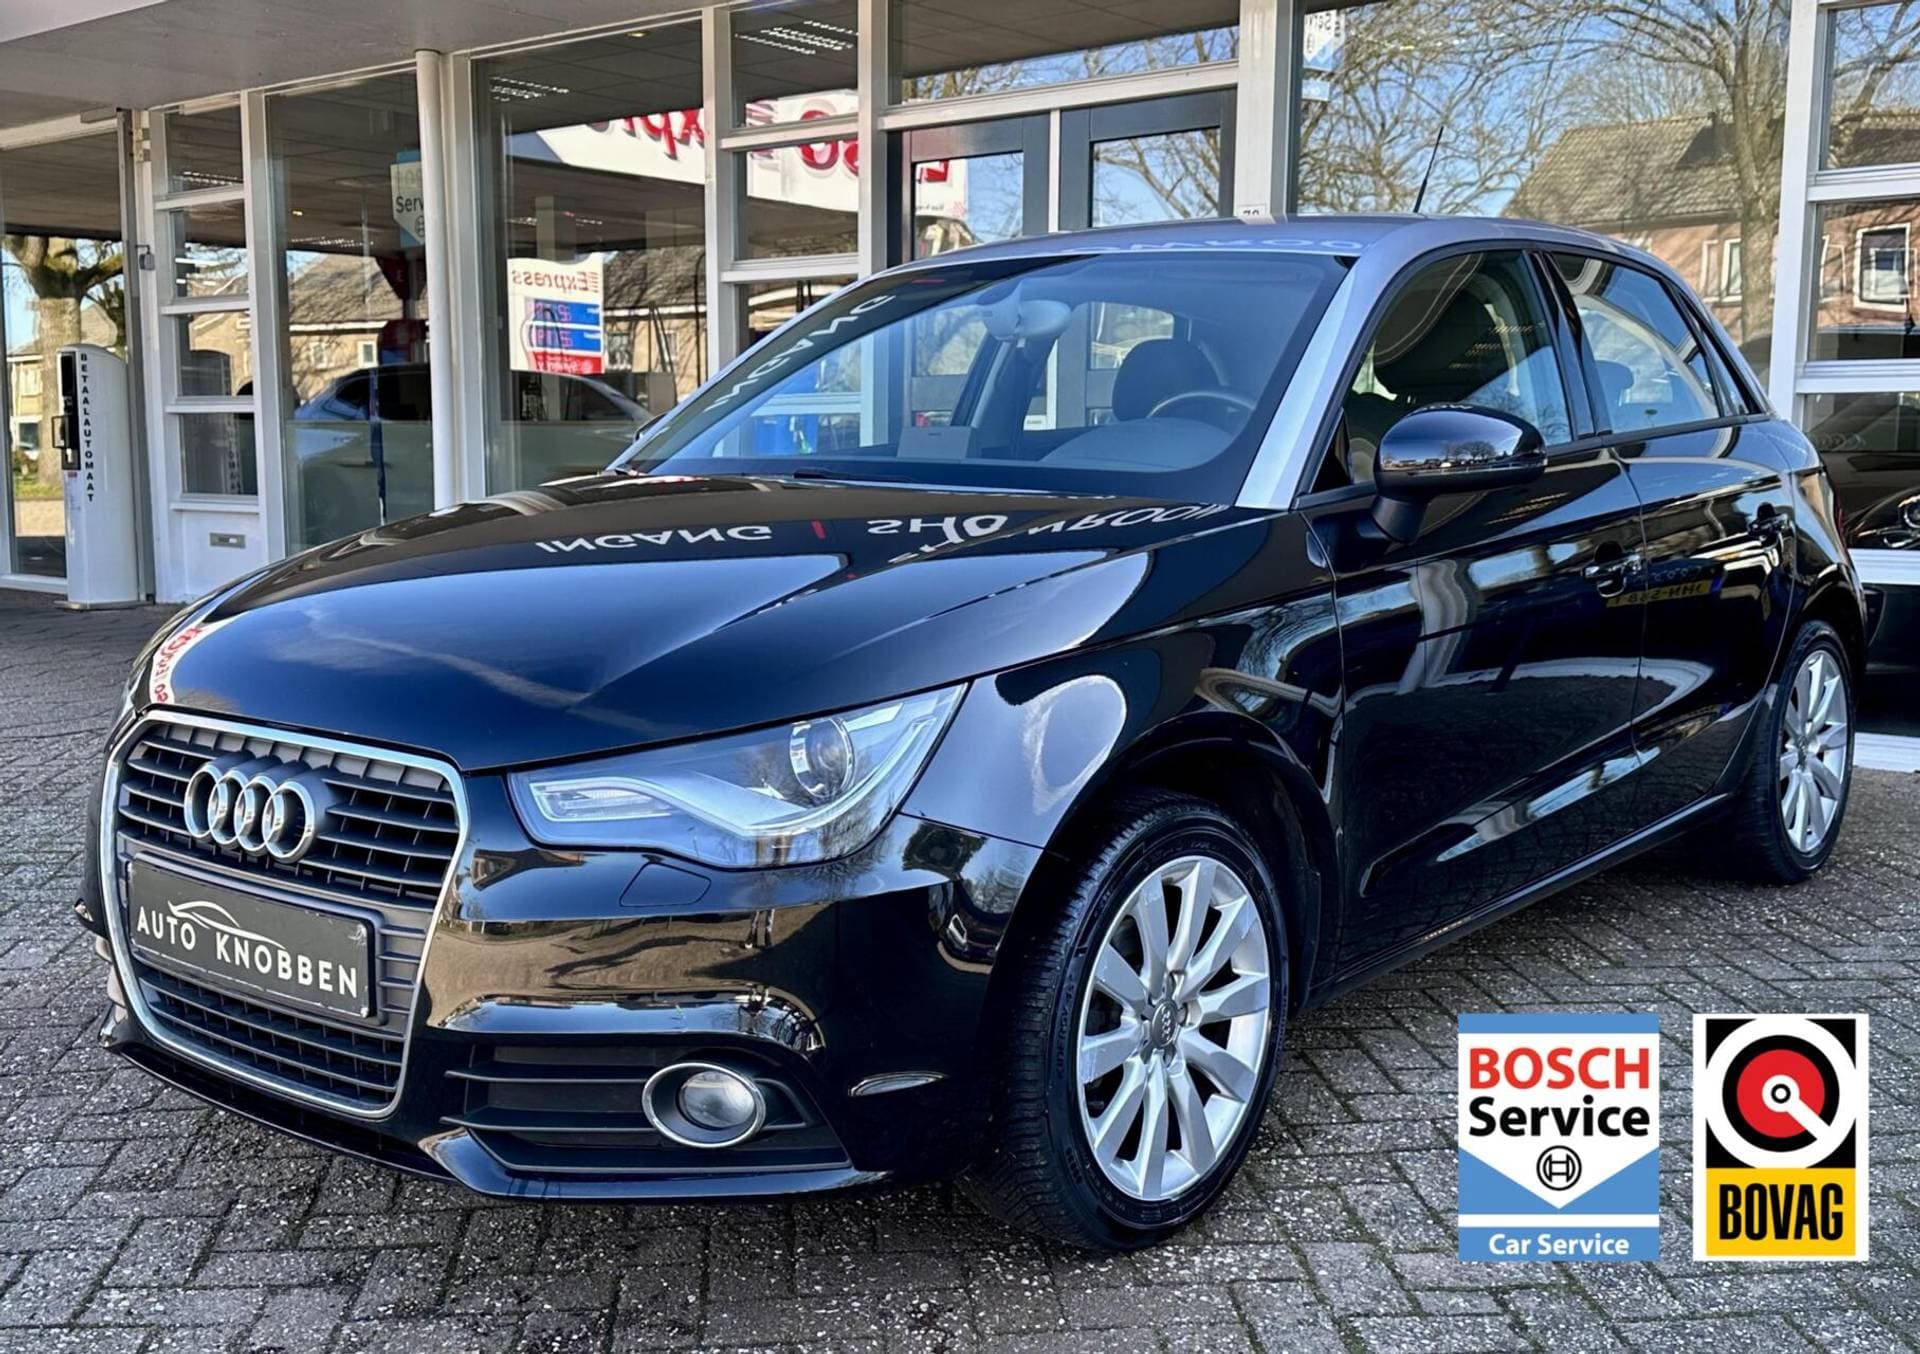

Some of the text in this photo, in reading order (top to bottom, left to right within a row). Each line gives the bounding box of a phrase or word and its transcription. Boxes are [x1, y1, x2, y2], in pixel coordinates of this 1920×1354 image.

[396, 196, 424, 213] Serv
[80, 353, 95, 502] BETAALAUTOMAAT
[137, 906, 357, 998] AUTO KNOBBEN
